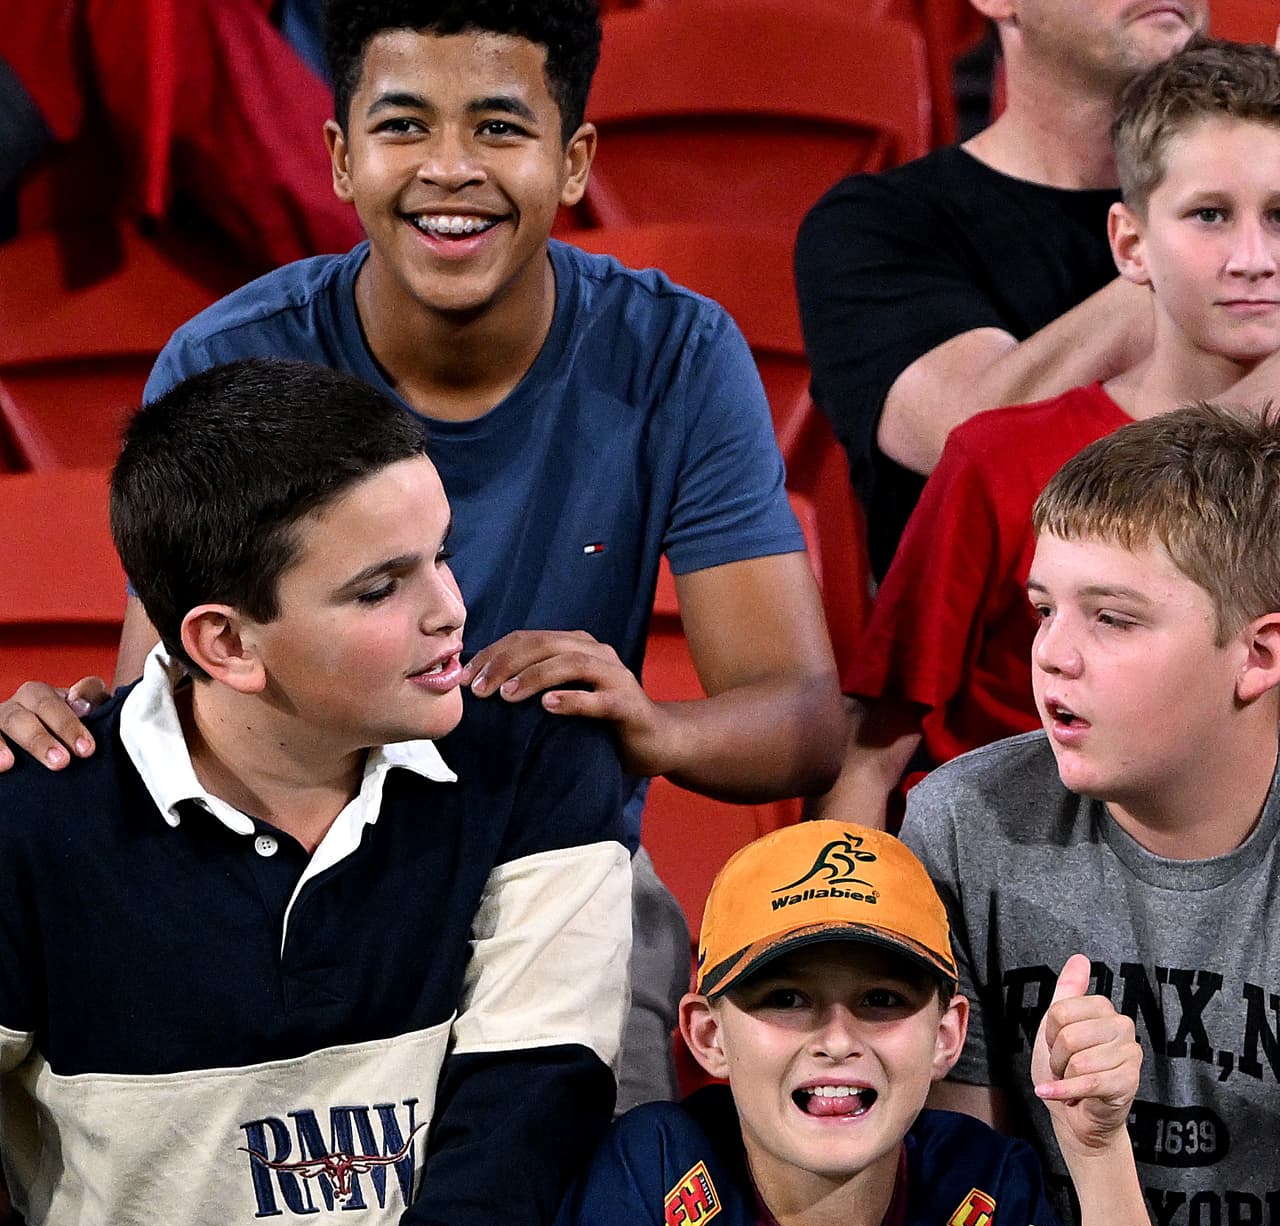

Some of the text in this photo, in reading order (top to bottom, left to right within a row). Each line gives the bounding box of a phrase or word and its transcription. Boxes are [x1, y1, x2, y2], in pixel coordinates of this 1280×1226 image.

[771, 887, 877, 911] Wallabies
[1153, 1118, 1217, 1155] 1639
[240, 1097, 420, 1218] RMW
